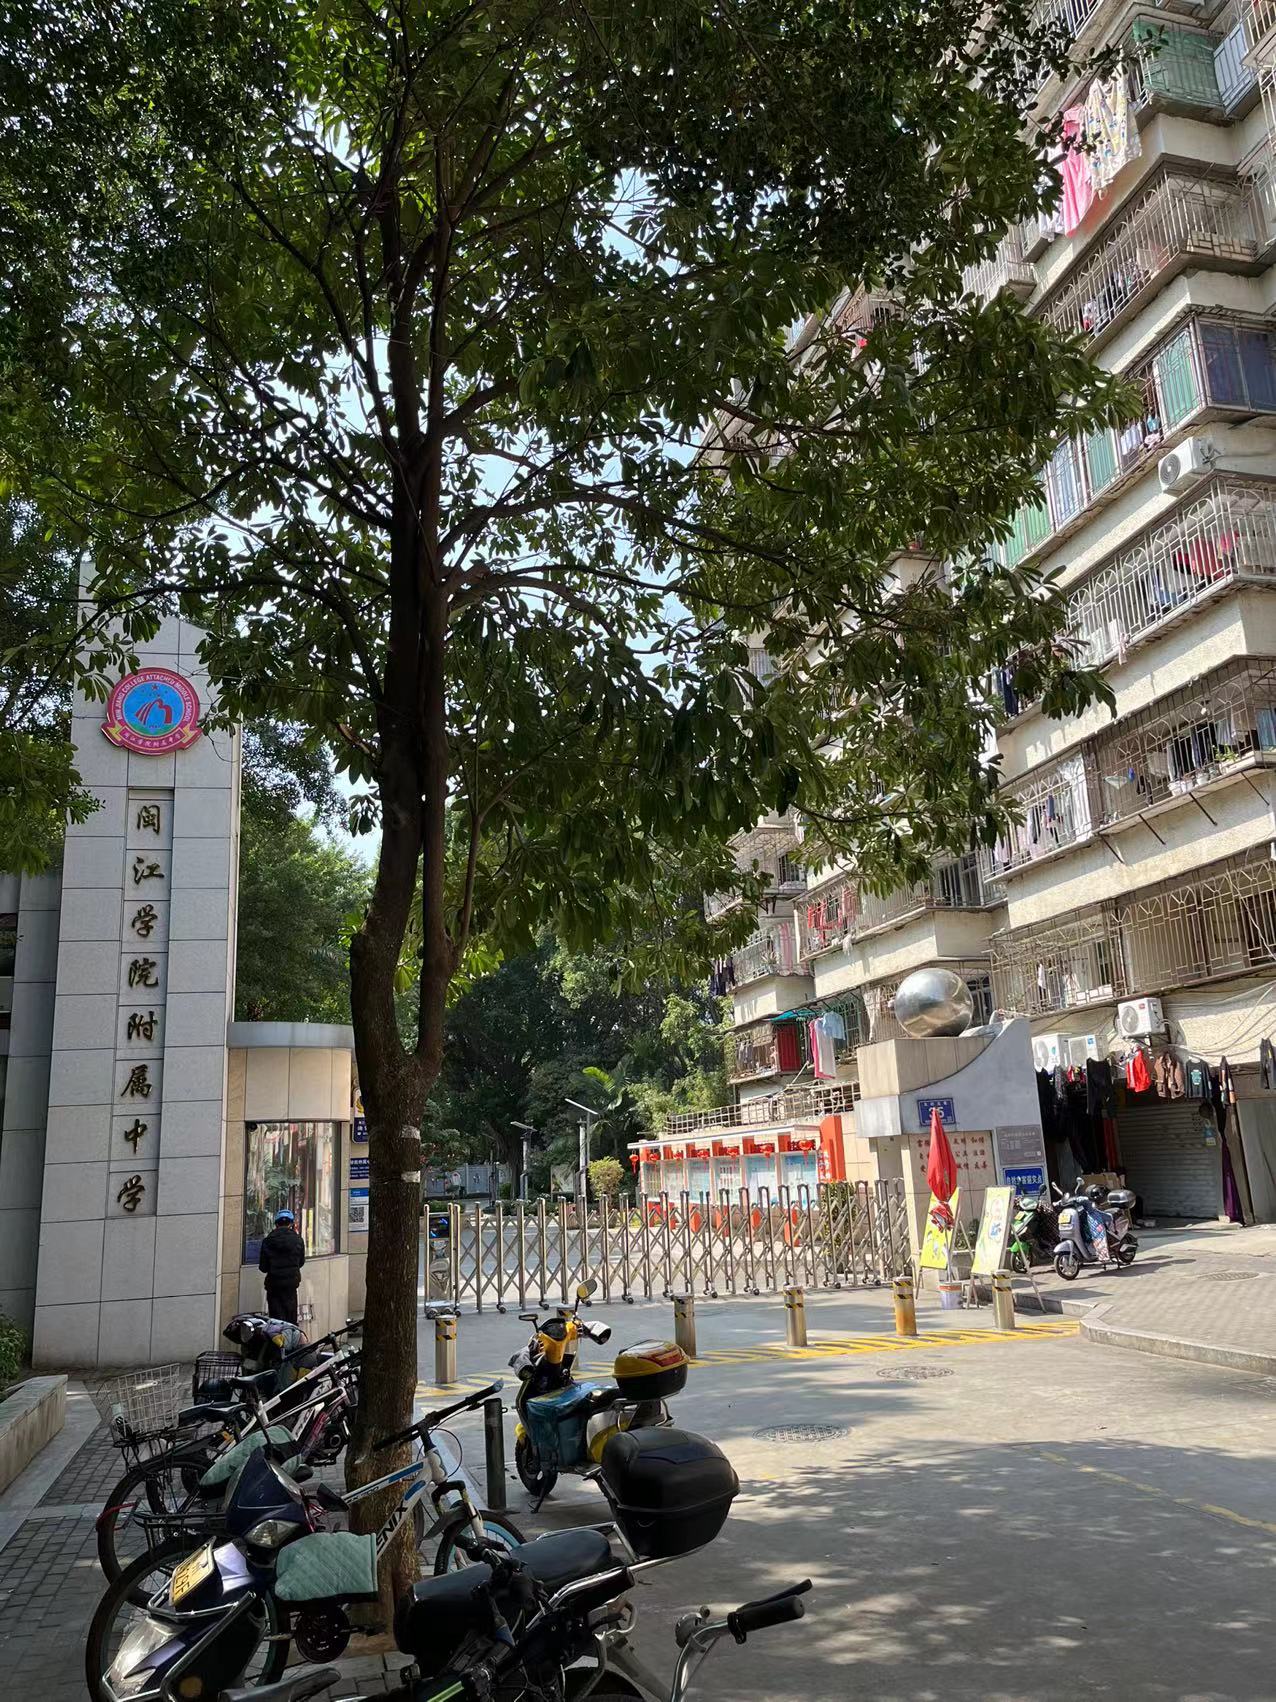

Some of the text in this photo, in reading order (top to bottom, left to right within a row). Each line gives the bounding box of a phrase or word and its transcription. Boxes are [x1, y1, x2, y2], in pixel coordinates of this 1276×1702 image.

[115, 692, 125, 708] JIANG
[122, 676, 145, 693] COLLEGE
[146, 674, 175, 685] ATTACHED
[174, 682, 190, 701] MIDDLE
[184, 701, 193, 722] SCHOOL
[117, 804, 164, 1212] 闽江学院附属中学
